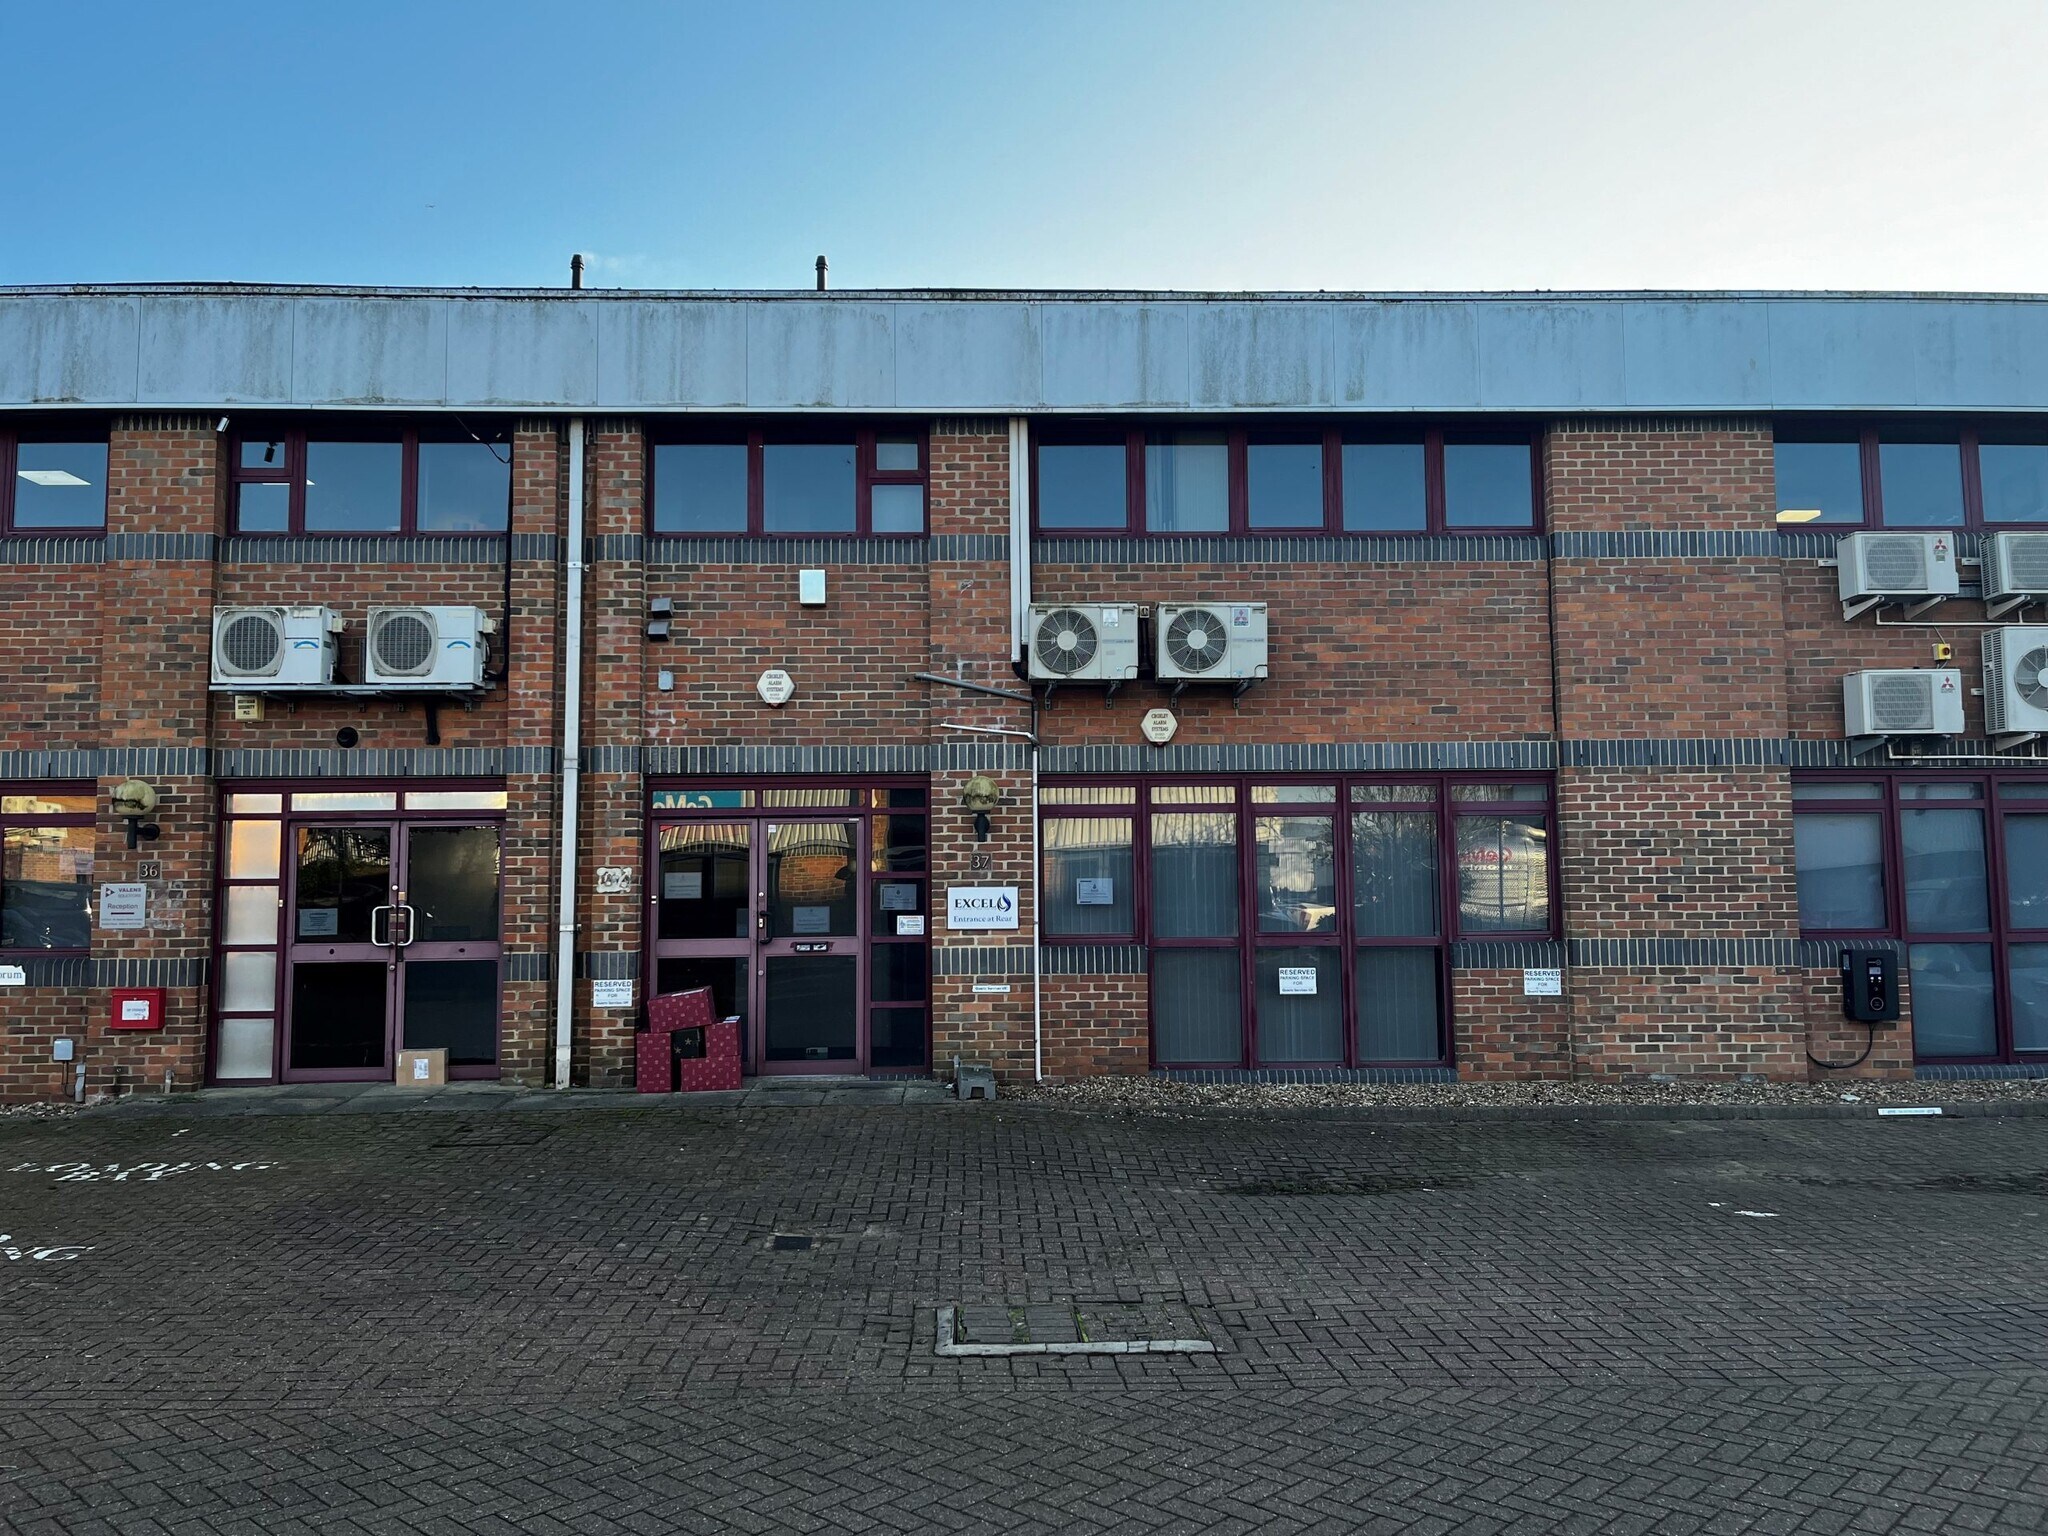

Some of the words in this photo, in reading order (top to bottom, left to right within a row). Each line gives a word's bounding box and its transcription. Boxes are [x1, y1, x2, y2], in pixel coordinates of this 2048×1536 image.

[972, 855, 989, 869] 37
[140, 864, 158, 877] 36
[955, 899, 996, 908] EXCEL
